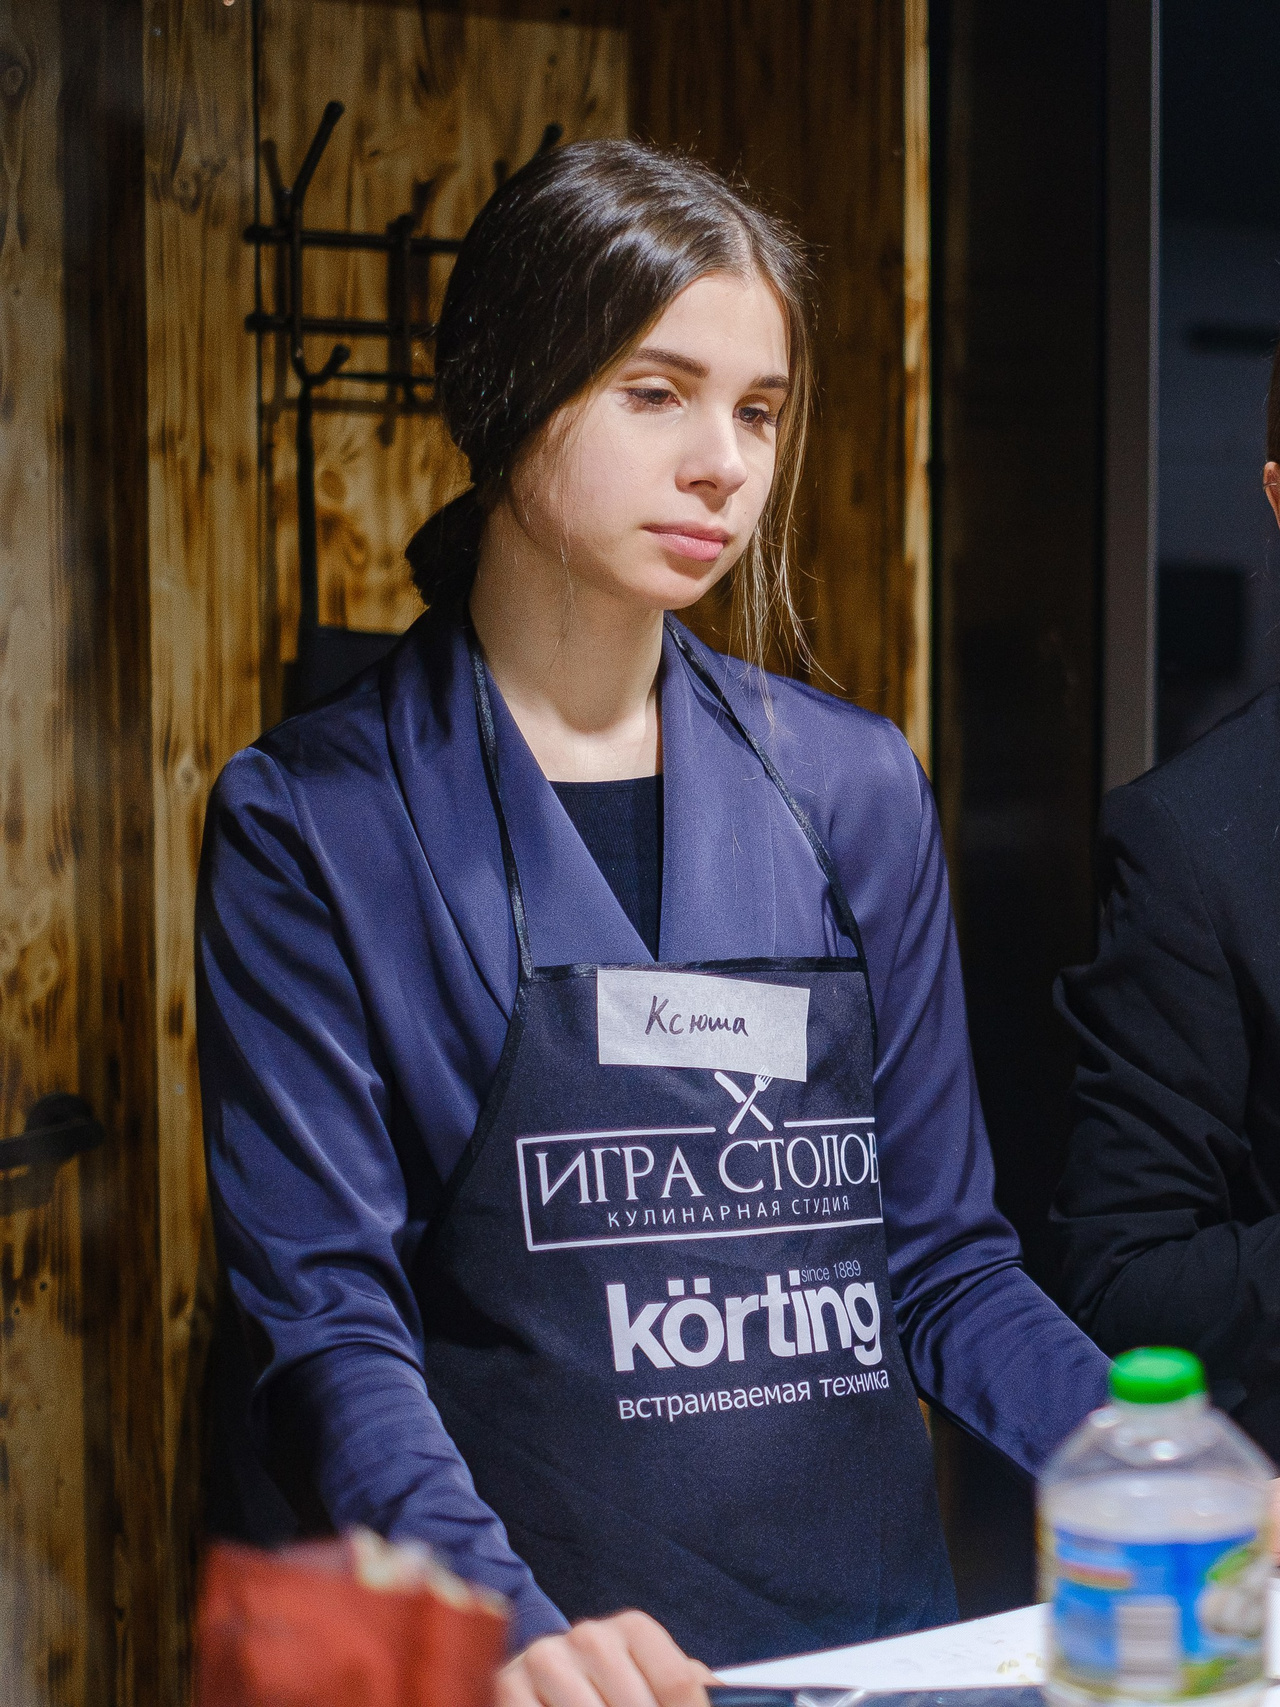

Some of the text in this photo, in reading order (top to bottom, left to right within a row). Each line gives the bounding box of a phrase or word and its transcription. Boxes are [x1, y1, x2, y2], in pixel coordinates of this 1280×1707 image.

[645, 995, 749, 1037] Ксюша
[535, 1132, 879, 1207] ИГРА СТОЛОВ
[608, 1195, 850, 1229] КУЛИНАРНАЯ СТУДИЯ
[801, 1259, 862, 1283] since 1889
[606, 1270, 883, 1371] körting
[618, 1369, 890, 1421] встраиваемая техника
